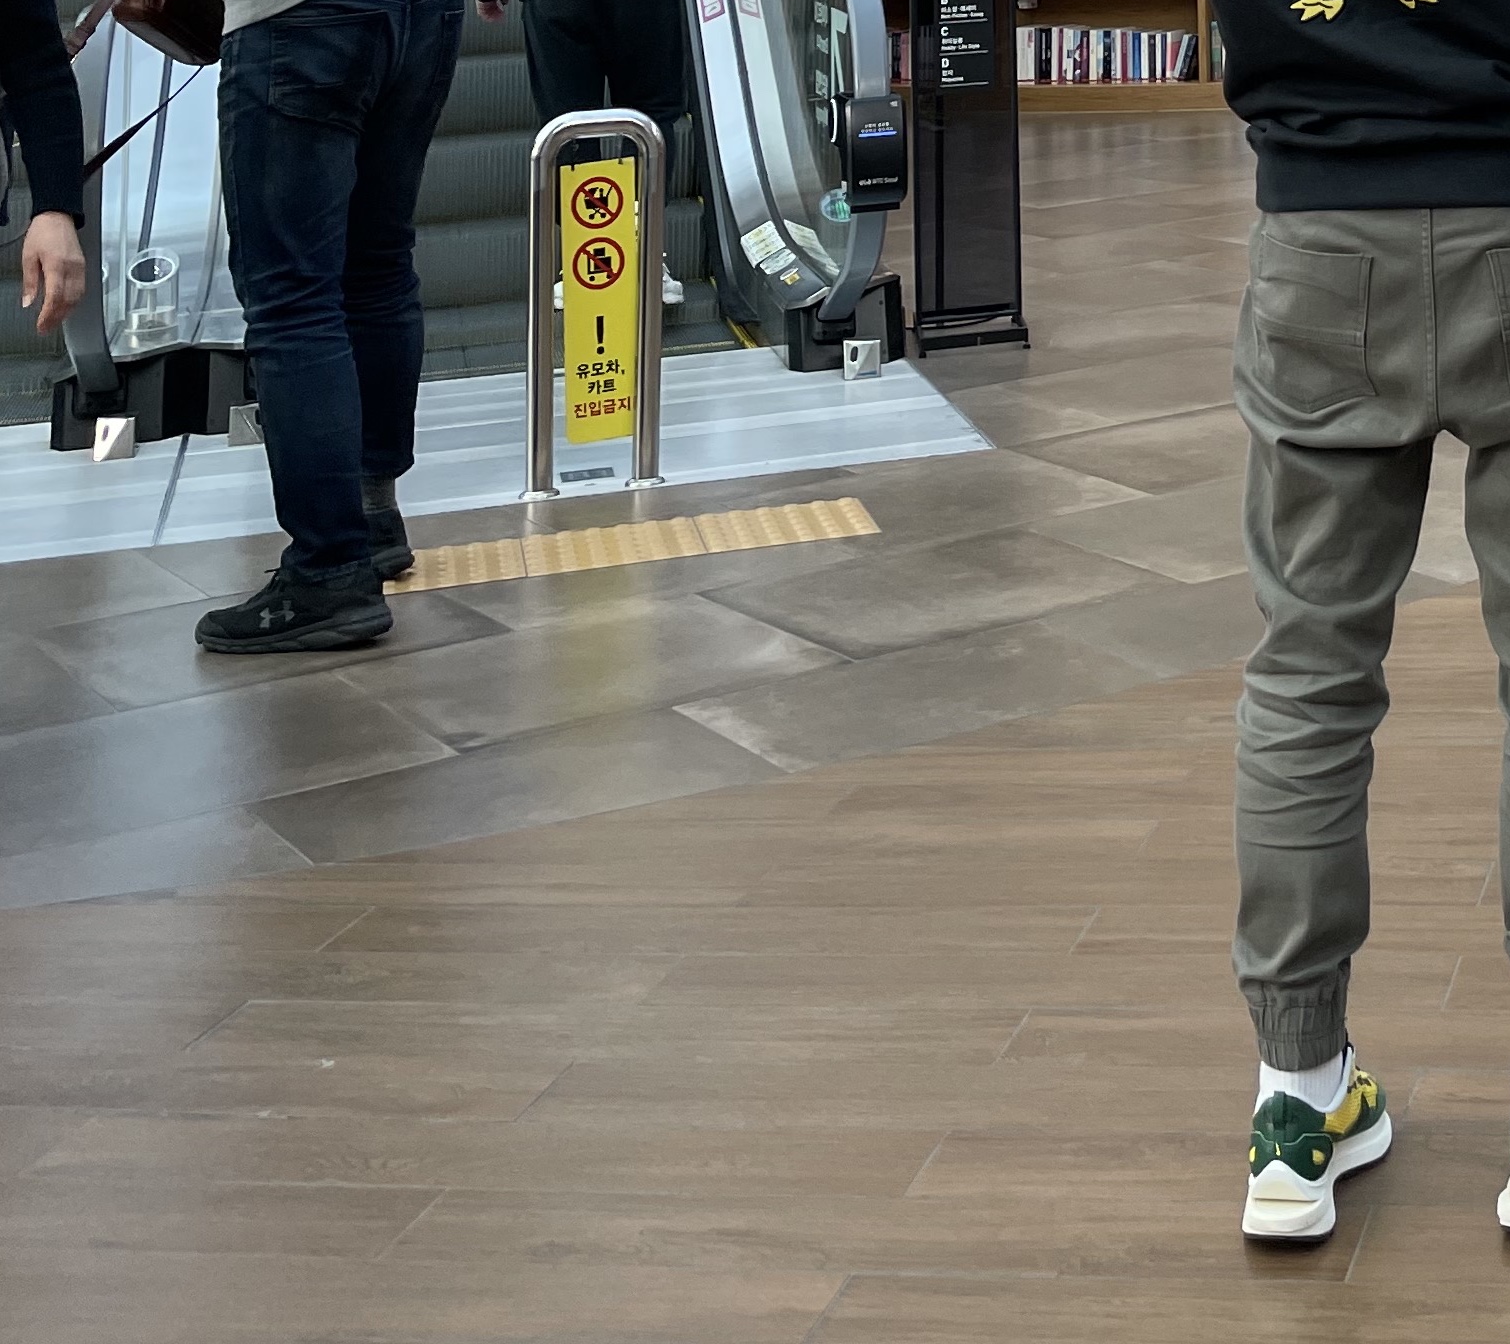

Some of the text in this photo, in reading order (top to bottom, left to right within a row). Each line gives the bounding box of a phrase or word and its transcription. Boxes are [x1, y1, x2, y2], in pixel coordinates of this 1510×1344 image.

[940, 26, 949, 37] C
[941, 58, 950, 68] D
[575, 359, 626, 379] 유모차,
[587, 378, 617, 395] 카트
[573, 399, 632, 419] 진입금지
